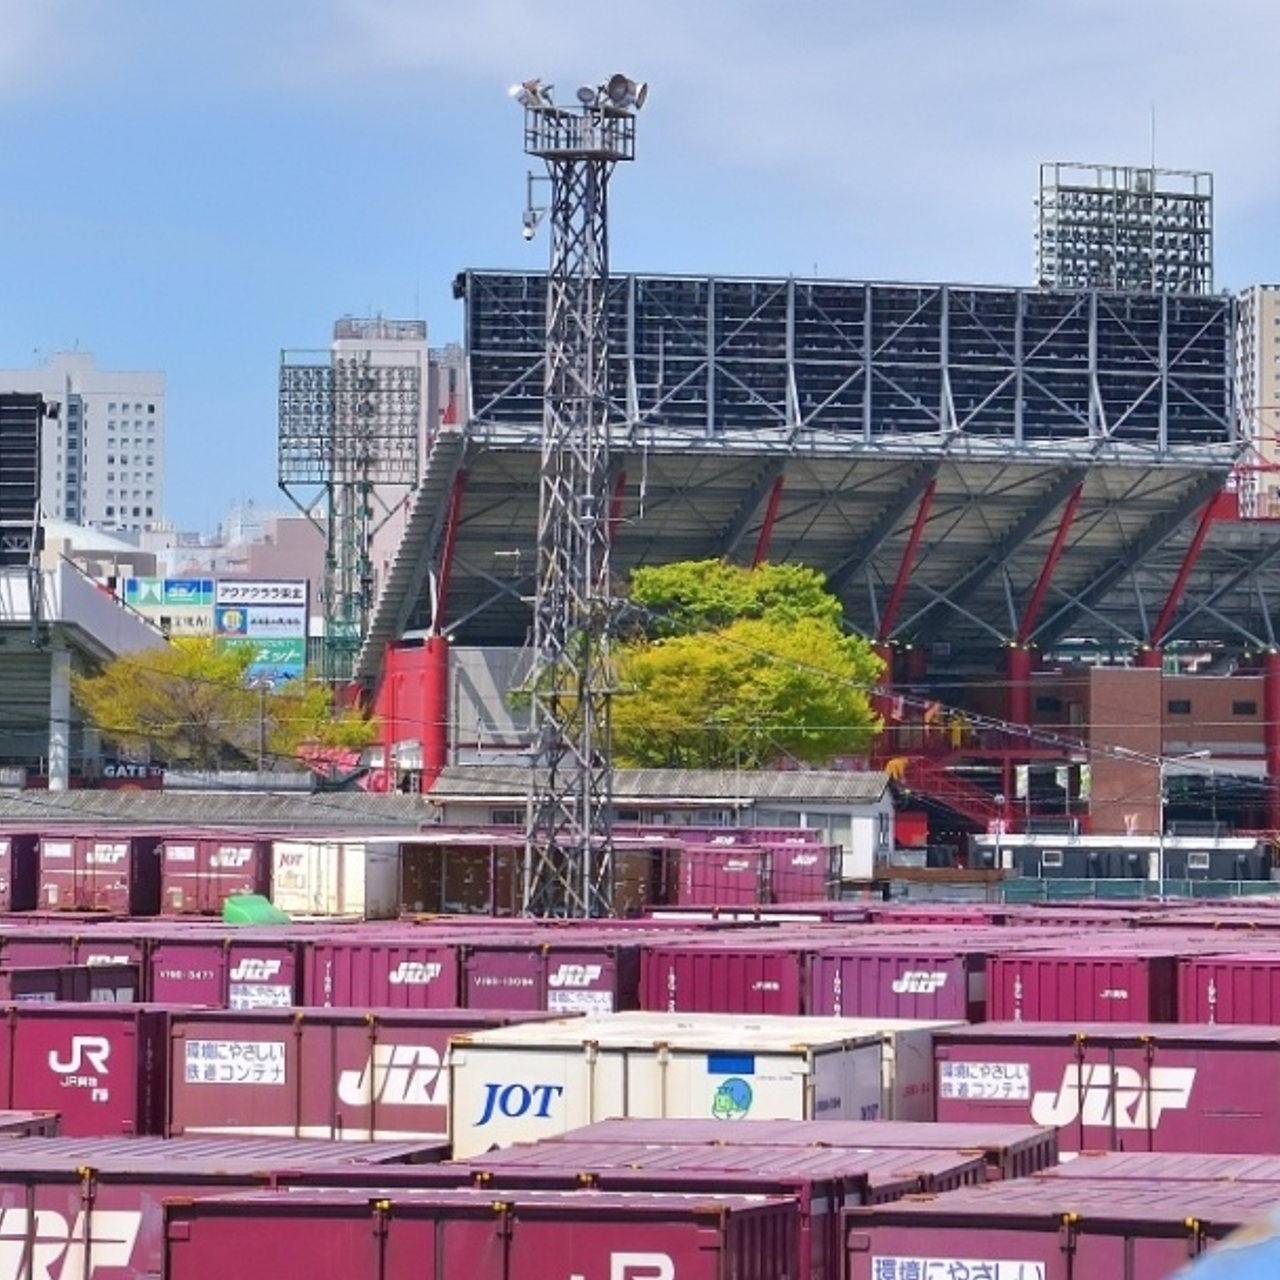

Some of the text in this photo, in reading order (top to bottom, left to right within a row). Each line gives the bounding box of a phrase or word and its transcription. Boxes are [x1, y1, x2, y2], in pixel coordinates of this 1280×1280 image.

[104, 765, 146, 778] GATE
[229, 958, 281, 980] JRF
[548, 965, 602, 987] JRF
[49, 1036, 111, 1074] JR
[187, 1042, 284, 1061] 環境にやさしい
[186, 1064, 284, 1083] 鉄道コンテナ
[337, 1044, 448, 1106] JR
[473, 1083, 563, 1127] JOT
[1030, 1063, 1197, 1130] JRF
